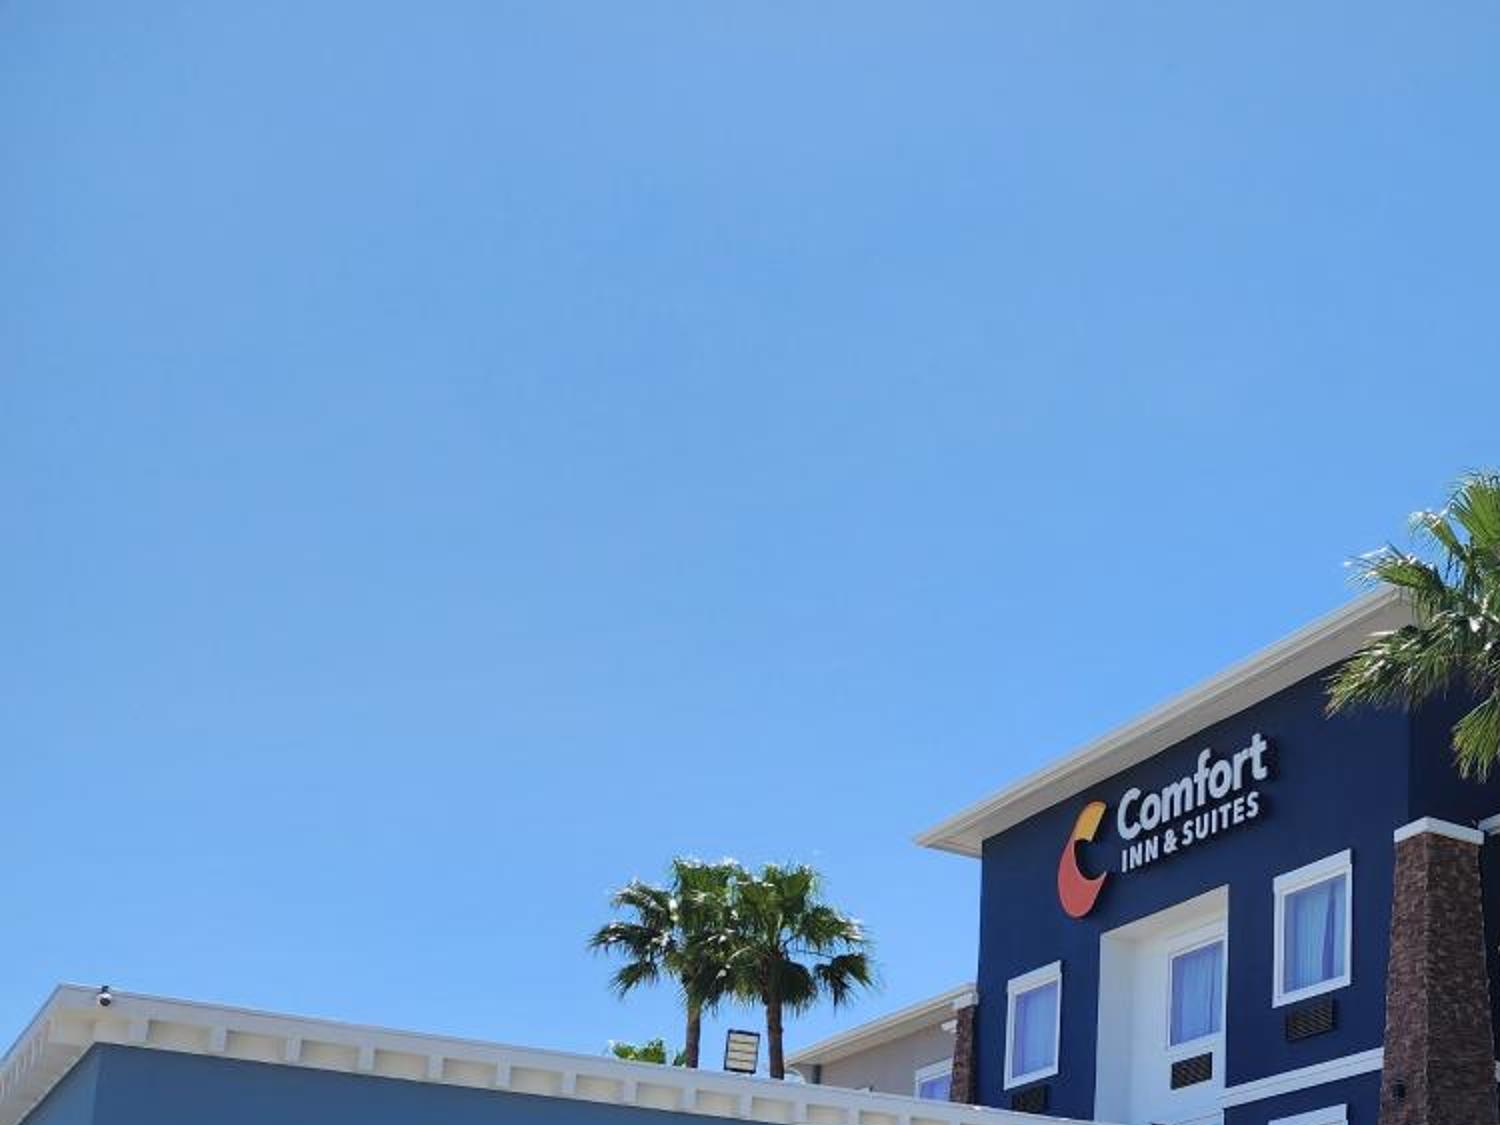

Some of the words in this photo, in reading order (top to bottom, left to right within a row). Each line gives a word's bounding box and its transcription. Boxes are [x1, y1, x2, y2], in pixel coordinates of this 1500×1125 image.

[1117, 733, 1268, 840] Comfort
[1121, 836, 1159, 873] INN
[1163, 829, 1178, 853] &
[1182, 791, 1259, 846] SUITES
